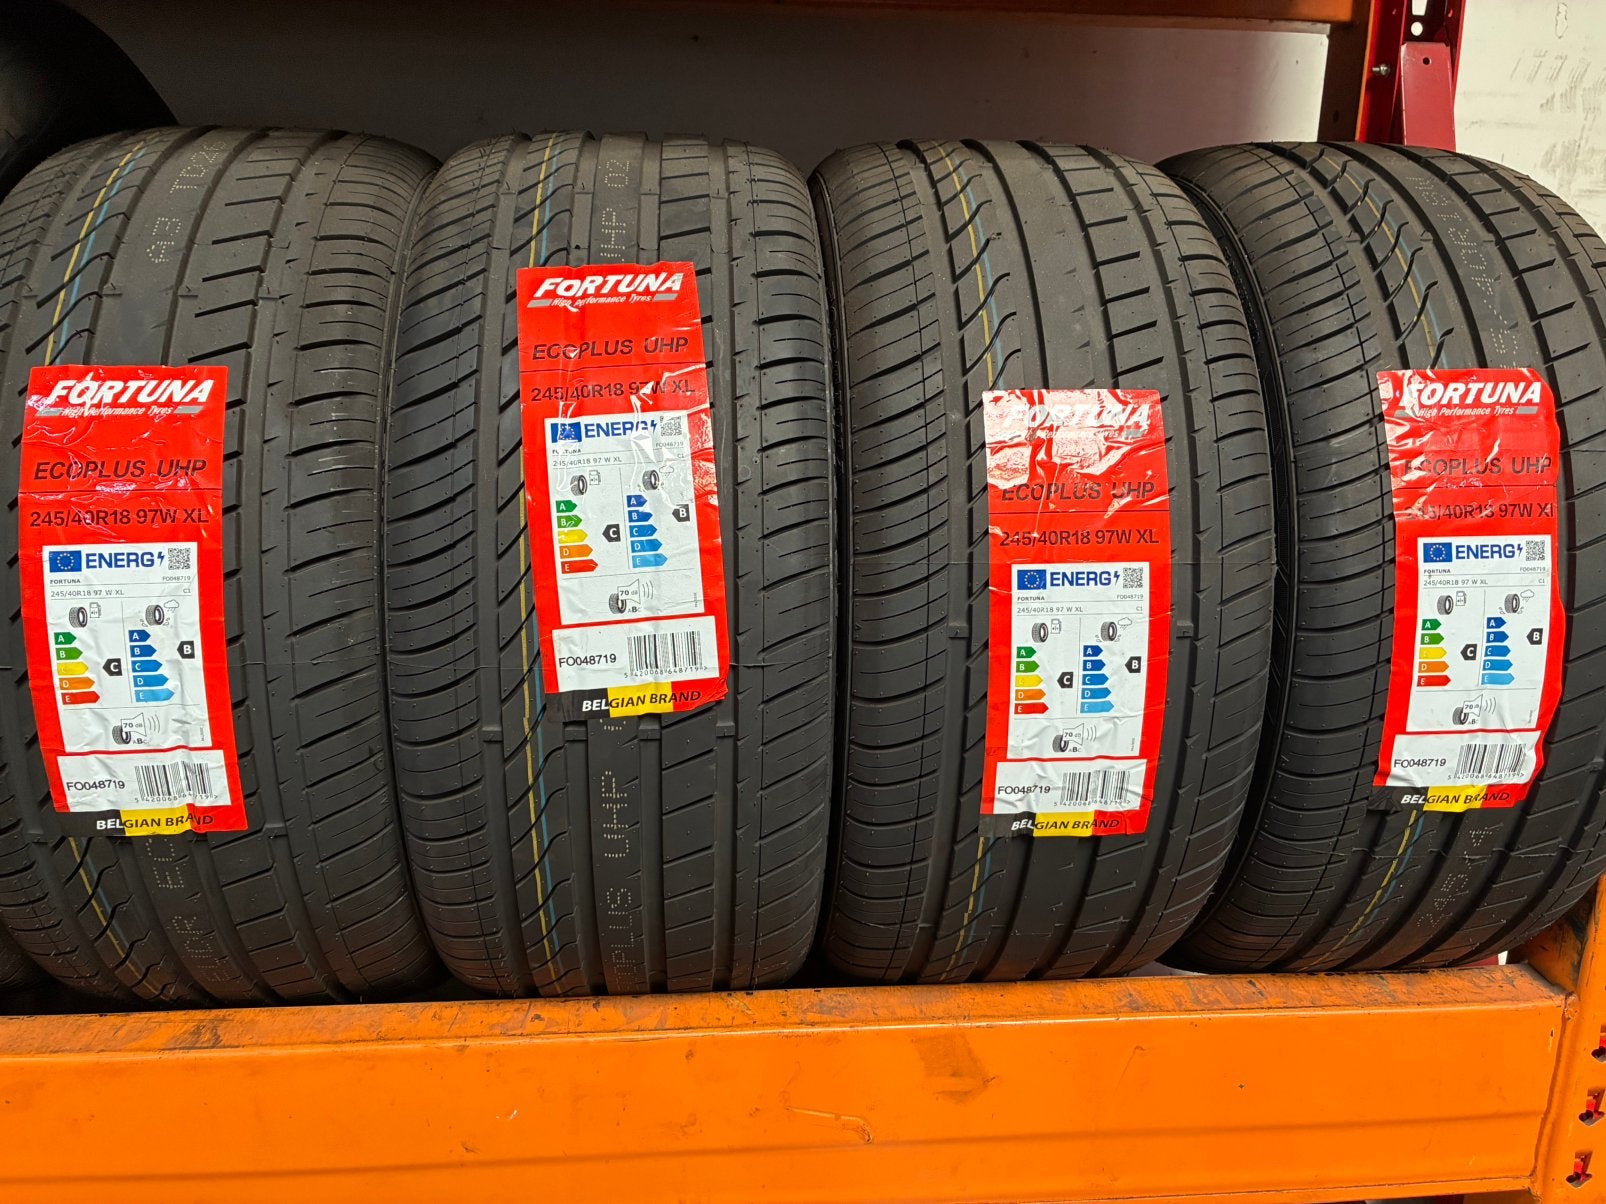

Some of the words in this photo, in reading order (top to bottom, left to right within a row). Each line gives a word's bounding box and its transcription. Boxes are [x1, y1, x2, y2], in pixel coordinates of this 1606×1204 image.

[534, 272, 684, 298] FORTUNA
[629, 294, 652, 303] Tyres
[532, 339, 633, 360] ECOPLUS
[644, 337, 688, 354] UHP
[49, 379, 215, 405] FORTUNA
[531, 383, 624, 402] 245/40R18
[671, 379, 696, 394] XL
[1400, 382, 1542, 407] FORTUNA
[148, 405, 173, 416] Tyres
[1418, 407, 1437, 418] High
[1439, 407, 1491, 416] Performance
[1494, 405, 1514, 416] Tyres
[34, 459, 145, 480] ECOPLUS
[157, 459, 206, 478] UHP
[1511, 457, 1553, 474] UHP
[1002, 483, 1102, 501] ECOPLUS
[1112, 482, 1155, 499] UHP
[630, 497, 637, 505] A
[632, 512, 638, 520] B
[679, 508, 687, 518] B
[1405, 504, 1495, 520] 25/40R18
[1499, 503, 1532, 517] 97W
[30, 510, 131, 527] 245/40R18
[136, 509, 177, 525] 97W
[183, 508, 208, 524] XL
[609, 528, 618, 538] C
[1000, 530, 1091, 546] 245/40R18
[1095, 529, 1132, 545] 97W
[1137, 529, 1159, 544] XL
[634, 543, 640, 551] D
[1455, 543, 1516, 560] ENERG
[86, 552, 155, 569] ENERG
[565, 564, 570, 572] E
[1050, 571, 1112, 586] ENERG
[1424, 621, 1431, 629] A
[1489, 619, 1496, 627] A
[58, 634, 65, 642] A
[132, 632, 140, 640] A
[1424, 635, 1429, 643] B
[1532, 632, 1540, 641] B
[134, 647, 141, 655] B
[183, 645, 192, 655] B
[1020, 649, 1026, 657] A
[1086, 647, 1093, 655] A
[1466, 648, 1474, 657] C
[559, 653, 617, 667] FO048719
[1131, 660, 1139, 669] B
[1485, 661, 1491, 669] D
[110, 662, 119, 672] C
[63, 680, 70, 688] D
[1063, 676, 1071, 685] C
[1085, 676, 1091, 684] C
[1484, 675, 1489, 683] E
[65, 695, 71, 703] E
[139, 692, 145, 700] E
[1084, 690, 1091, 698] D
[582, 694, 646, 712] BELGIAN
[649, 690, 701, 704] BRAND
[1394, 758, 1446, 769] FO048719
[66, 780, 125, 791] FO048719
[998, 784, 1051, 795] FO048719
[1401, 794, 1461, 804] BELGIAN
[1463, 792, 1510, 804] BRAND
[601, 770, 630, 858] UHP
[96, 818, 161, 829] BELGIAN
[165, 815, 213, 827] BRAND
[1011, 819, 1069, 830] BELGIAN
[1072, 819, 1120, 829] BRAND
